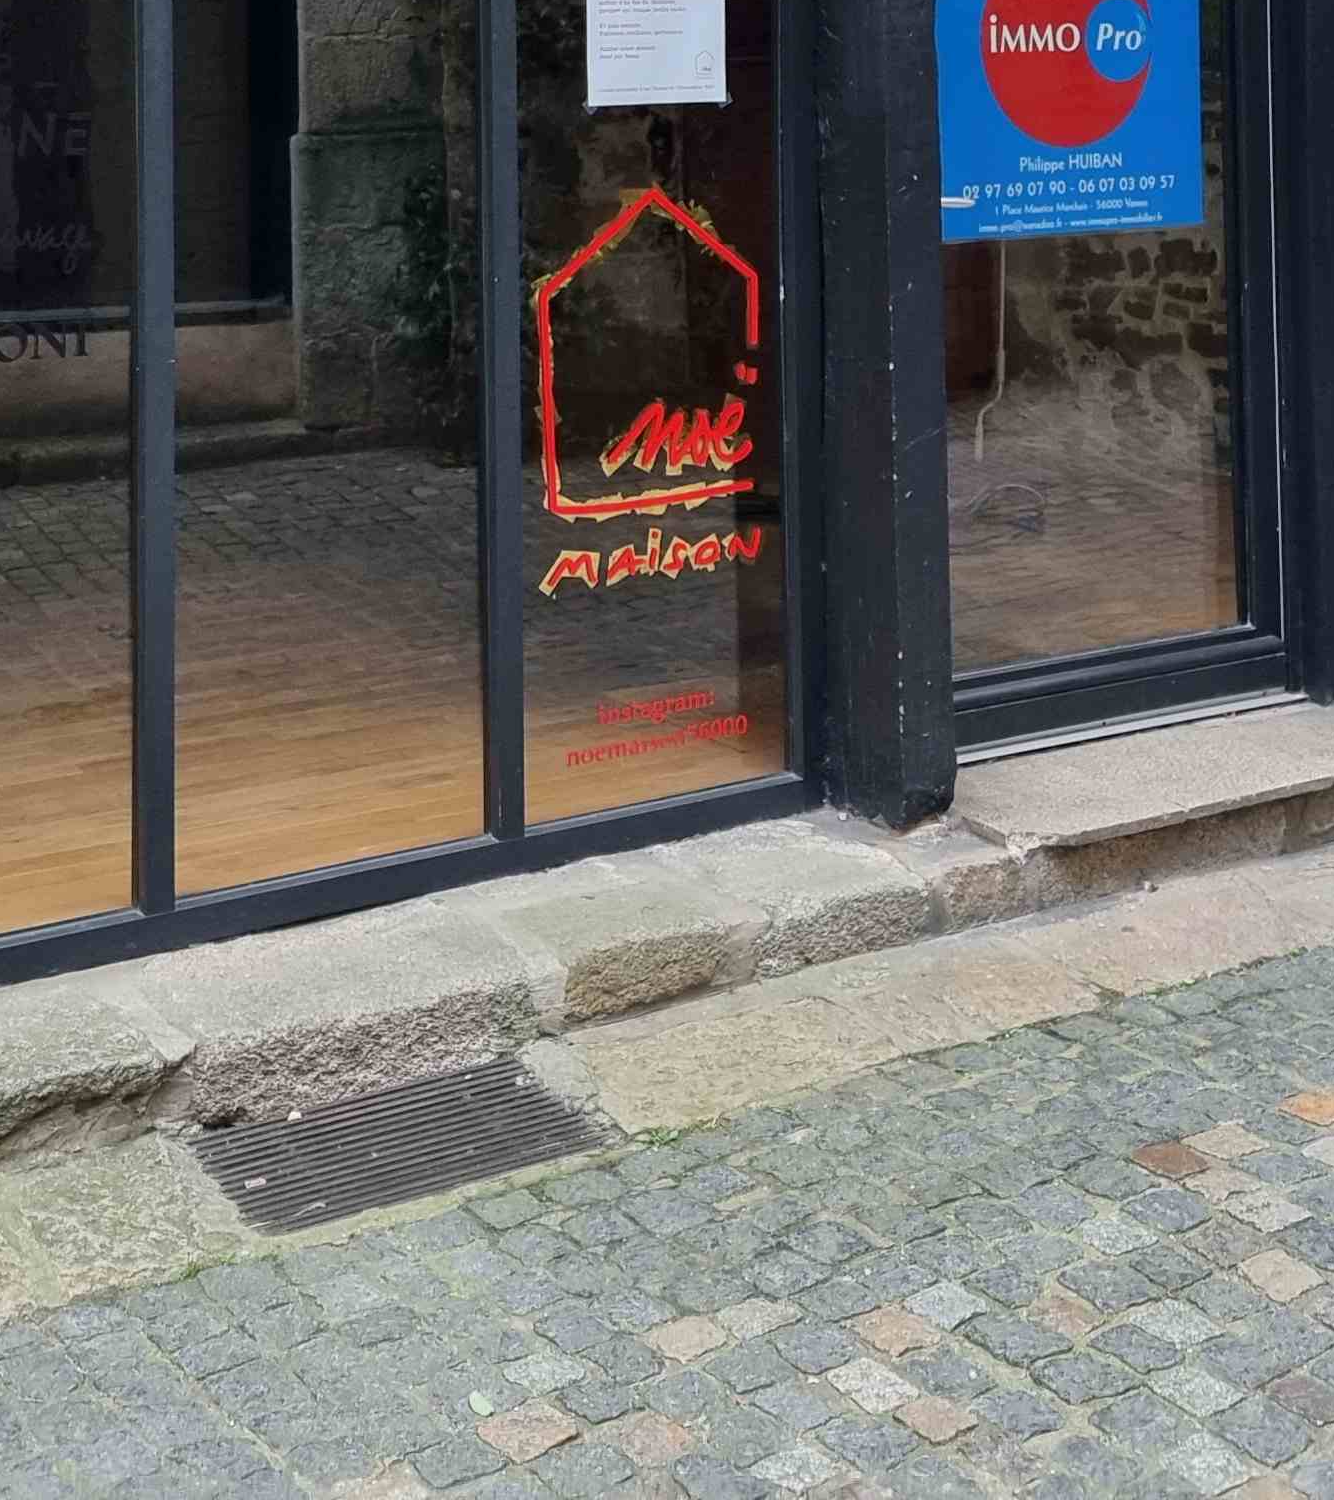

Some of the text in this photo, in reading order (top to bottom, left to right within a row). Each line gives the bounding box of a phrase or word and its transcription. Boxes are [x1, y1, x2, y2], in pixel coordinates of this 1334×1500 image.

[1095, 22, 1144, 52] Pro
[1018, 153, 1124, 175] Philippe HUIBAN
[962, 185, 980, 200] 02
[984, 184, 1002, 198] 97
[1007, 182, 1024, 197] 69
[1027, 181, 1044, 196] 07
[1049, 180, 1067, 194] 90
[1078, 178, 1095, 193] 06
[1099, 177, 1116, 192] 07
[1119, 176, 1135, 191] 03
[1139, 175, 1156, 189] 09
[1160, 174, 1176, 188] 57
